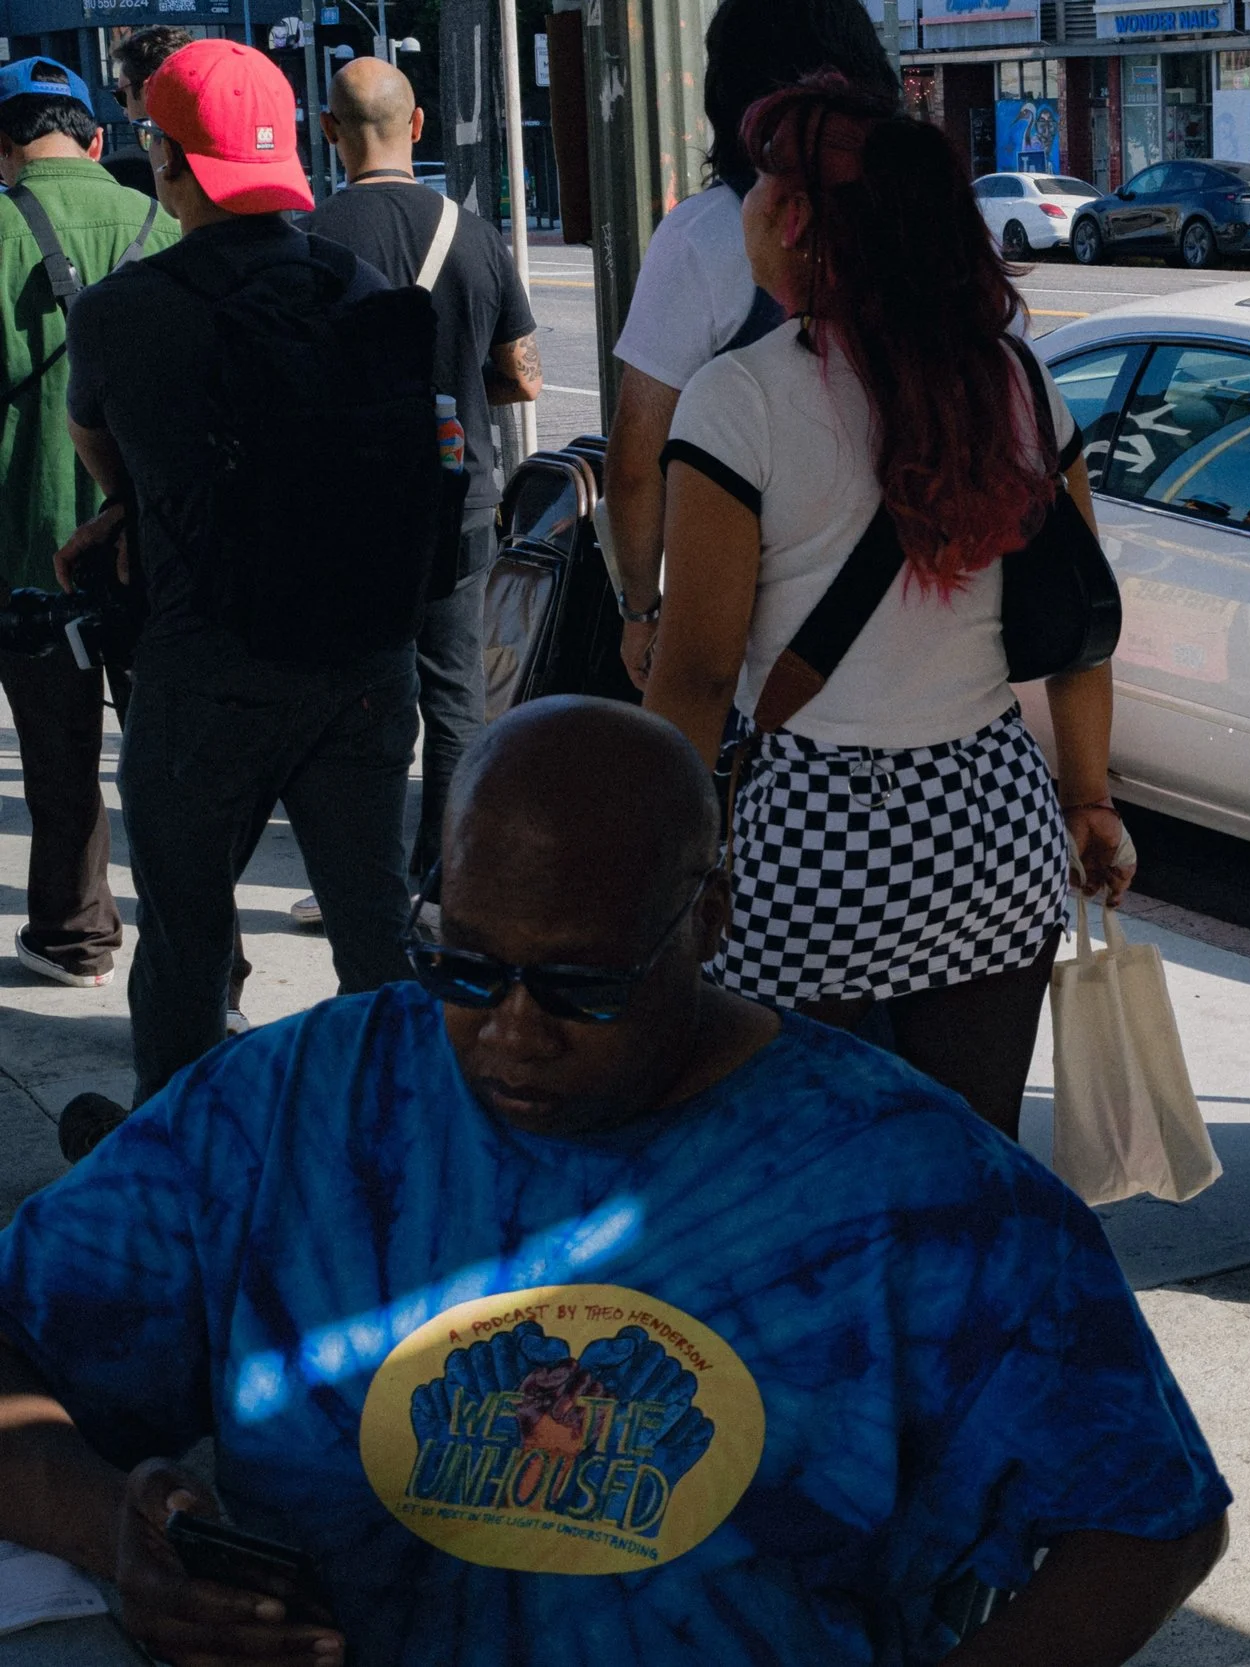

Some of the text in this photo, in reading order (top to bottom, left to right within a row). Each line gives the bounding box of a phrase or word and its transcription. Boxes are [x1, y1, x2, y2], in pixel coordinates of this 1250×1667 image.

[1114, 8, 1220, 33] WONDER NAILS
[449, 1304, 714, 1371] A PODCAST BY THEO HENDERSON
[450, 1385, 668, 1458] WE THE
[405, 1437, 670, 1535] UNHOUSED
[506, 1517, 541, 1529] LIGHT
[556, 1523, 660, 1561] UNDERSTANDING
